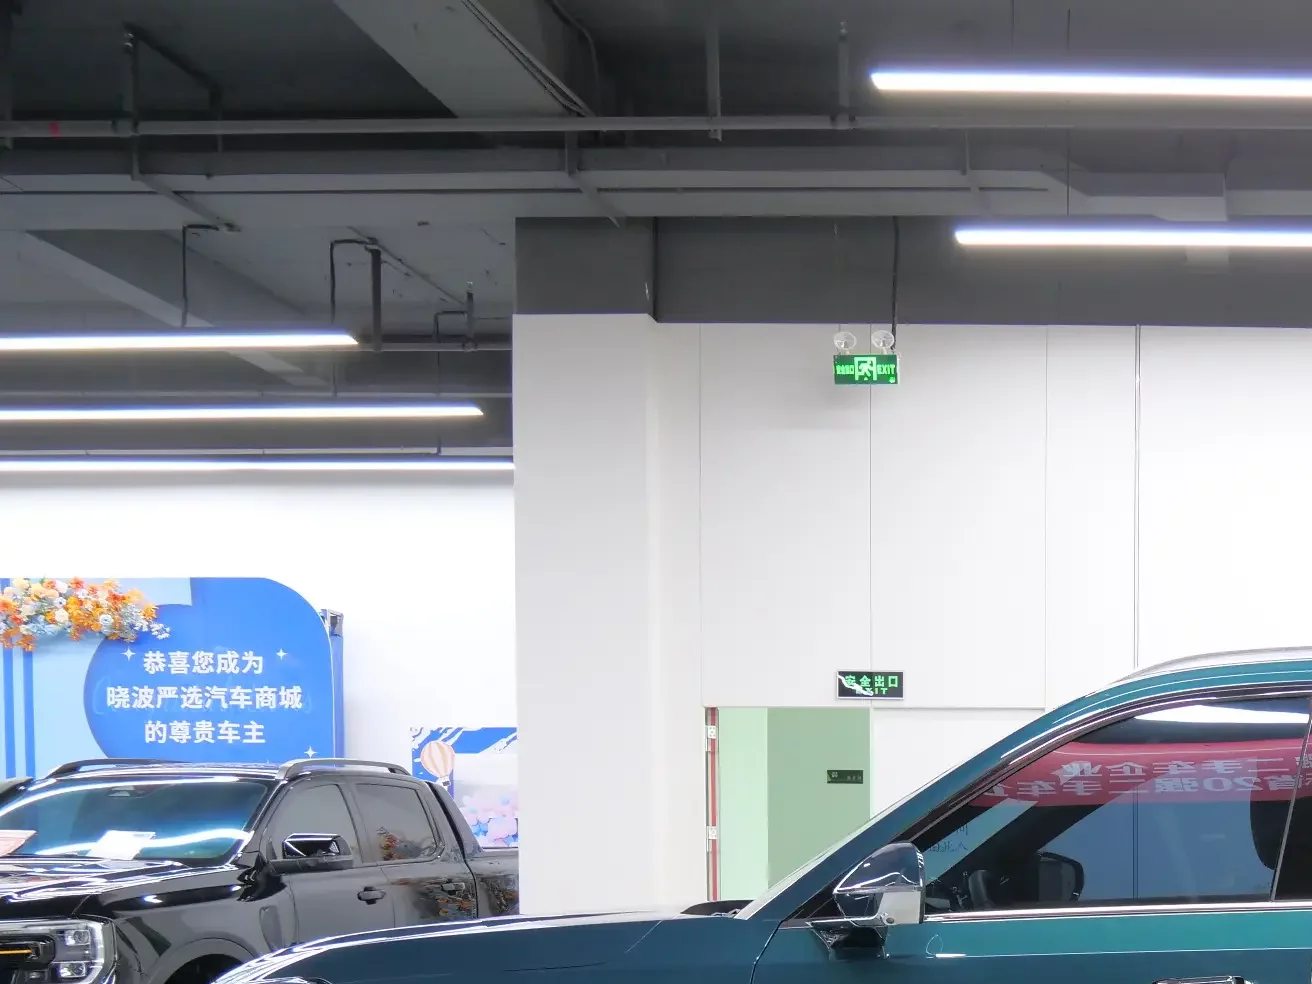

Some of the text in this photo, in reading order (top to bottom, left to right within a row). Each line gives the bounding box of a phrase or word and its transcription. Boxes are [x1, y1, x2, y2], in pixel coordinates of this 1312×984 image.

[876, 364, 896, 375] EXIT
[143, 650, 264, 675] 恭喜您成为
[845, 675, 898, 687] 安全出口
[106, 685, 303, 711] 晓波严选汽车商城
[144, 720, 266, 745] 的尊贵车主
